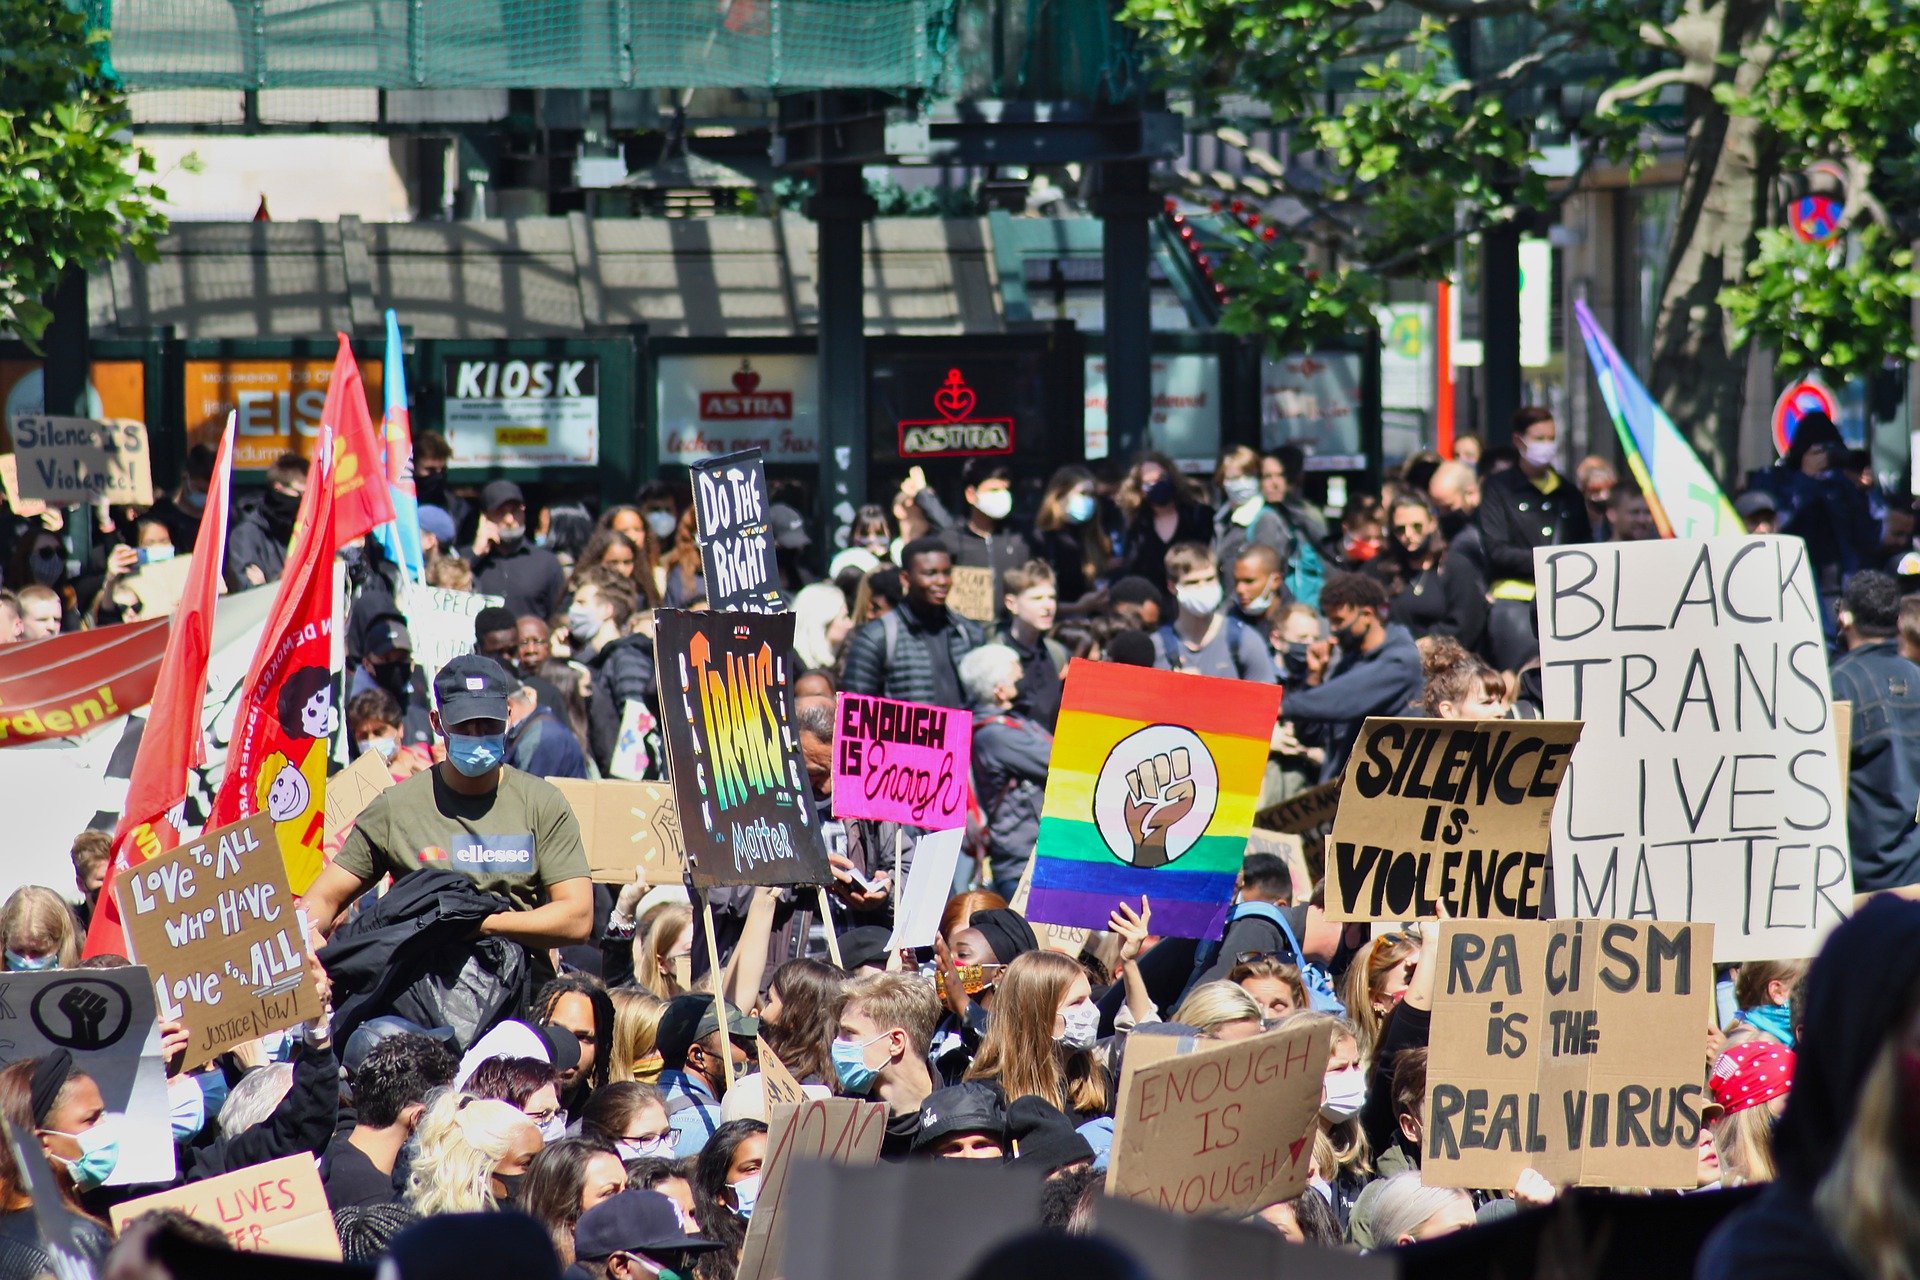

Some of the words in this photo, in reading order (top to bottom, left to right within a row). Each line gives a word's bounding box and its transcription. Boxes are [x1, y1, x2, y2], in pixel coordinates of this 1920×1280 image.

[457, 360, 585, 398] KIOSK
[705, 397, 787, 414] ASTRA
[237, 389, 328, 437] EIS
[904, 423, 1010, 453] ASTRA
[36, 458, 136, 490] Violence!
[726, 468, 762, 525] THE
[1546, 541, 1815, 641] BLACK
[1546, 641, 1828, 737] TRANS
[689, 630, 786, 812] TRANS
[842, 698, 947, 750] ENOUGH
[840, 740, 862, 777] IS
[864, 740, 962, 821] Enough
[1355, 723, 1572, 806] SILENCE
[1566, 749, 1832, 842] LIVES
[1420, 805, 1470, 845] IS
[215, 827, 260, 880] ALL
[456, 844, 530, 864] ellesse
[1336, 842, 1546, 918] VIOLENCE
[1571, 835, 1849, 936] MATTER
[250, 928, 302, 988] ALL
[1549, 1010, 1600, 1057] THE
[1139, 1034, 1312, 1123] ENOUGH
[1193, 1102, 1241, 1157] IS
[1429, 1084, 1547, 1160] REAL
[1563, 1084, 1703, 1151] VIRUS
[216, 1178, 297, 1224] LIVES
